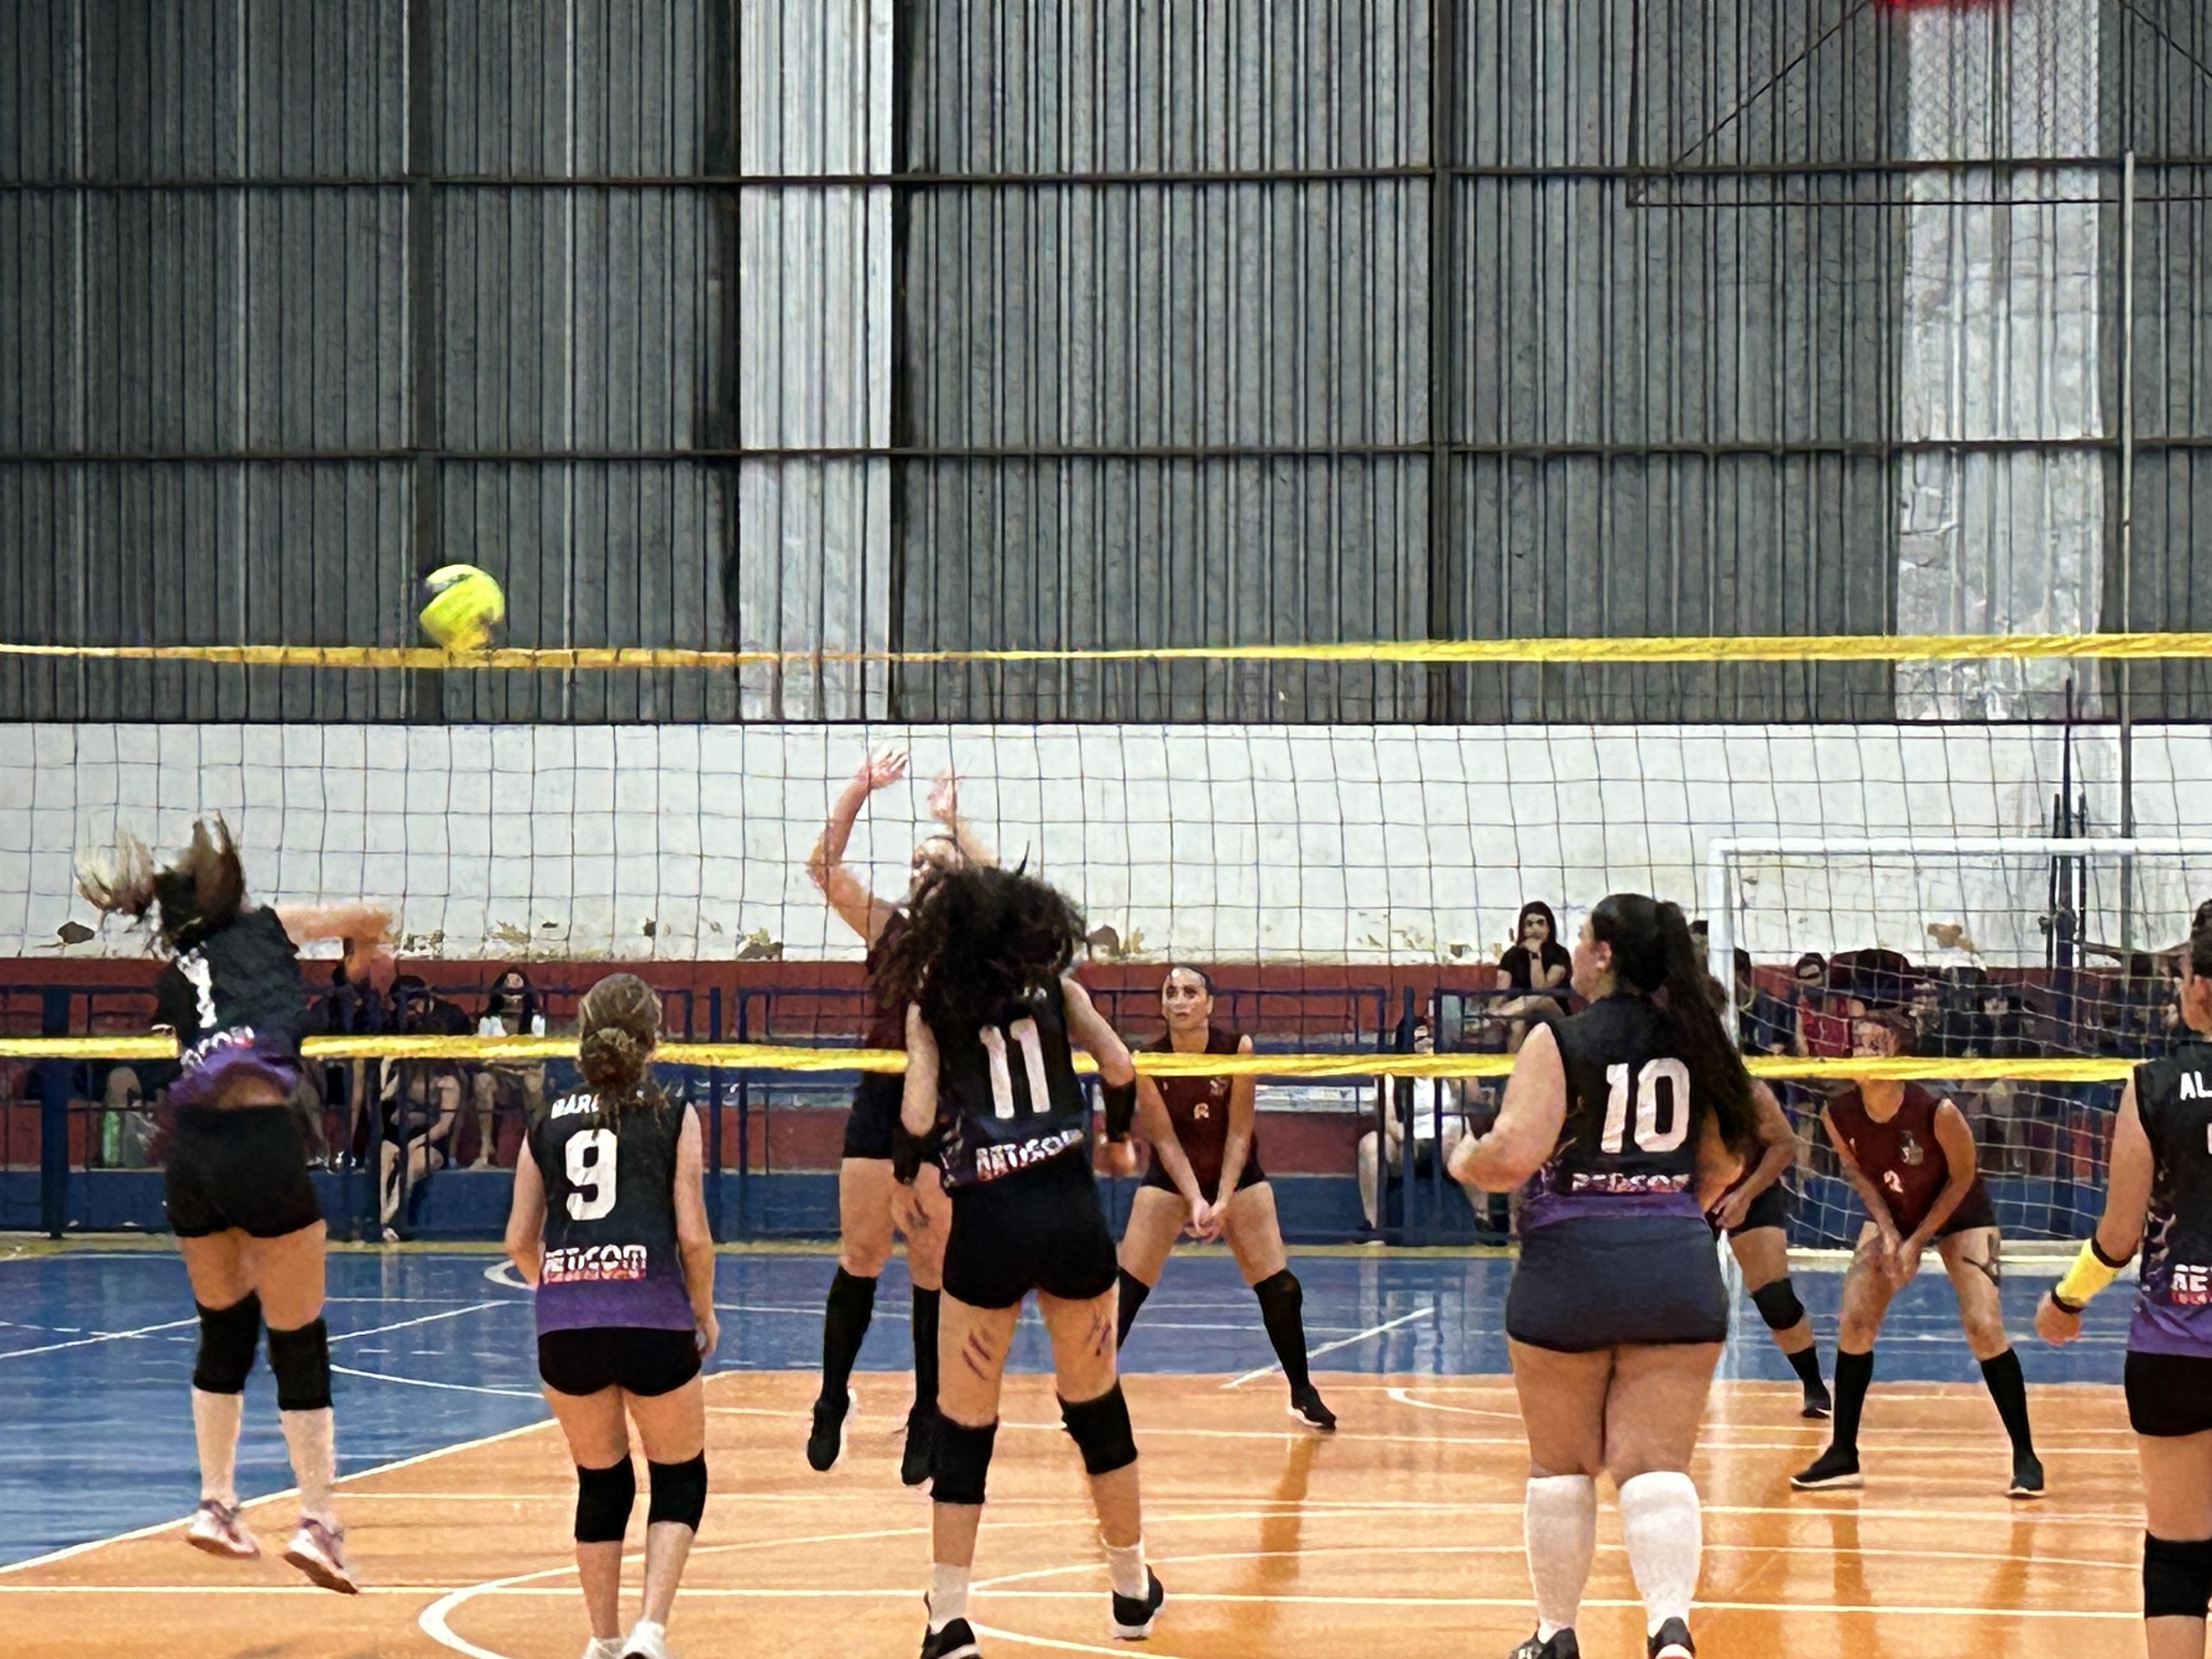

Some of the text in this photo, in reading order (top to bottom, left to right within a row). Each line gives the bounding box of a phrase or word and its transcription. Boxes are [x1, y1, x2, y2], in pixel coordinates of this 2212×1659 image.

[979, 1019, 1050, 1119] 11
[1601, 1057, 1690, 1154] 10
[565, 1128, 617, 1221] 9
